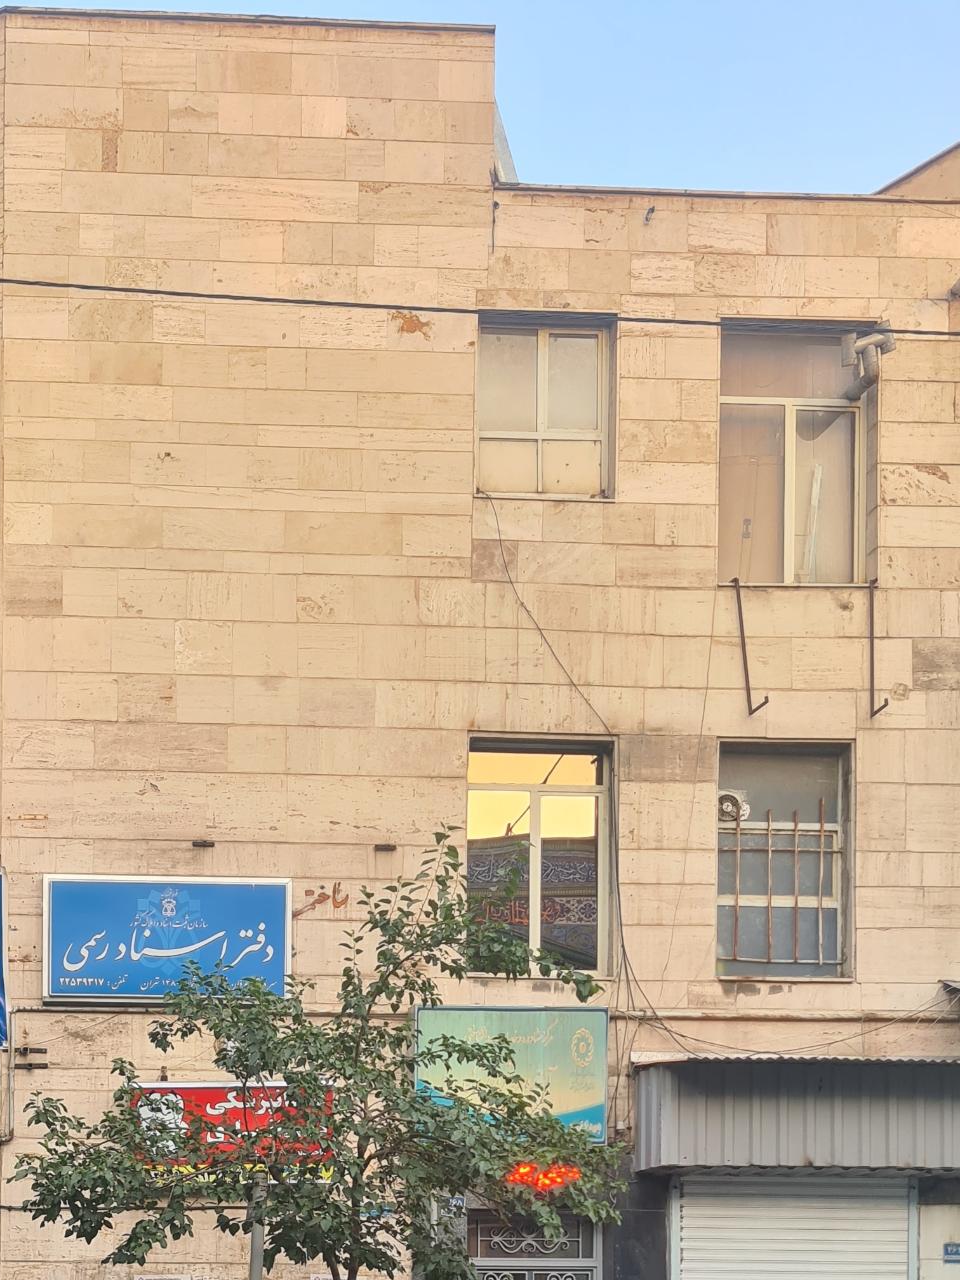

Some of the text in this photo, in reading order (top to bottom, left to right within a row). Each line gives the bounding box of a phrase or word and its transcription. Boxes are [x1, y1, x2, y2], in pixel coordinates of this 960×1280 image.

[62, 922, 274, 972] دفتر اسناد رسمی
[59, 977, 105, 987] ۲۲۵۳۹۳۱۷
[140, 976, 161, 991] تهران
